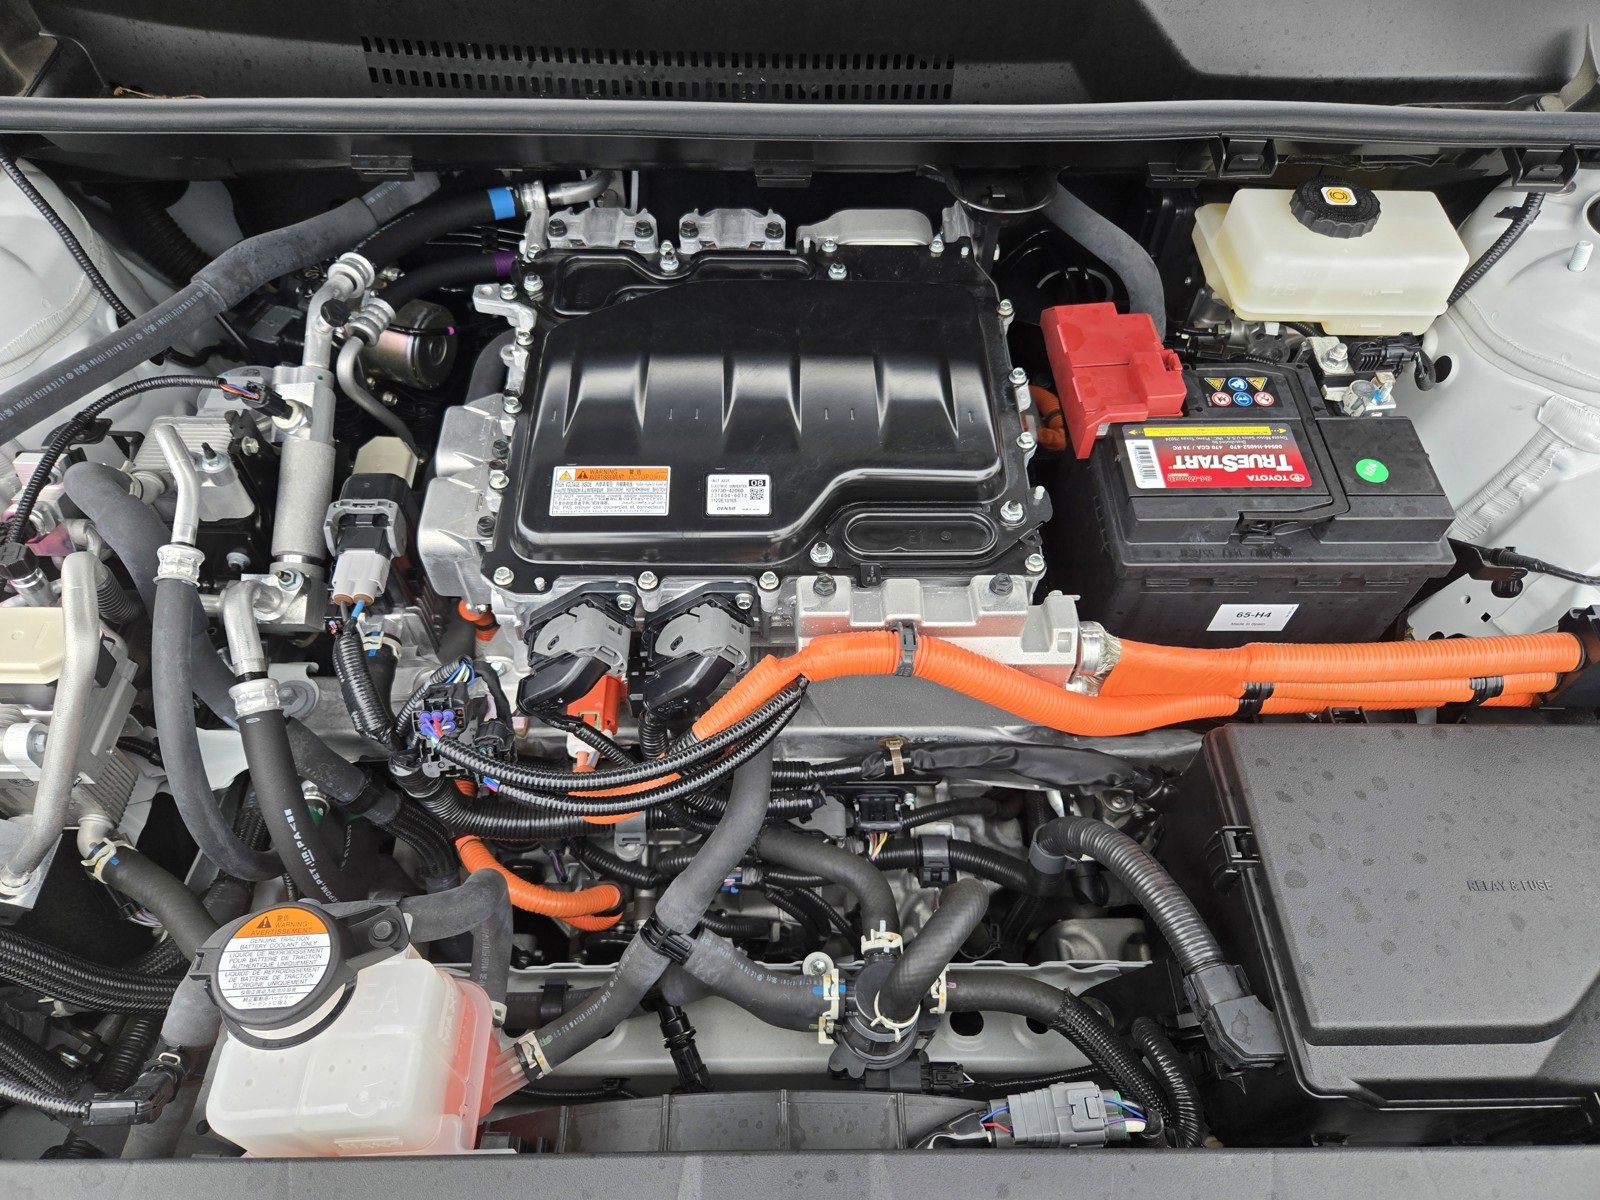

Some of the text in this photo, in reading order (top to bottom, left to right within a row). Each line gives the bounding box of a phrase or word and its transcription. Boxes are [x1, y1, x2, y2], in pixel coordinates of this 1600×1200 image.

[1466, 881, 1506, 891] RELAY
[1520, 880, 1554, 891] FUSE
[251, 927, 312, 936] AVERTISSEMENT
[268, 948, 324, 956] REFROIDISSEMENT
[263, 967, 320, 975] REFROIDISSEMENT
